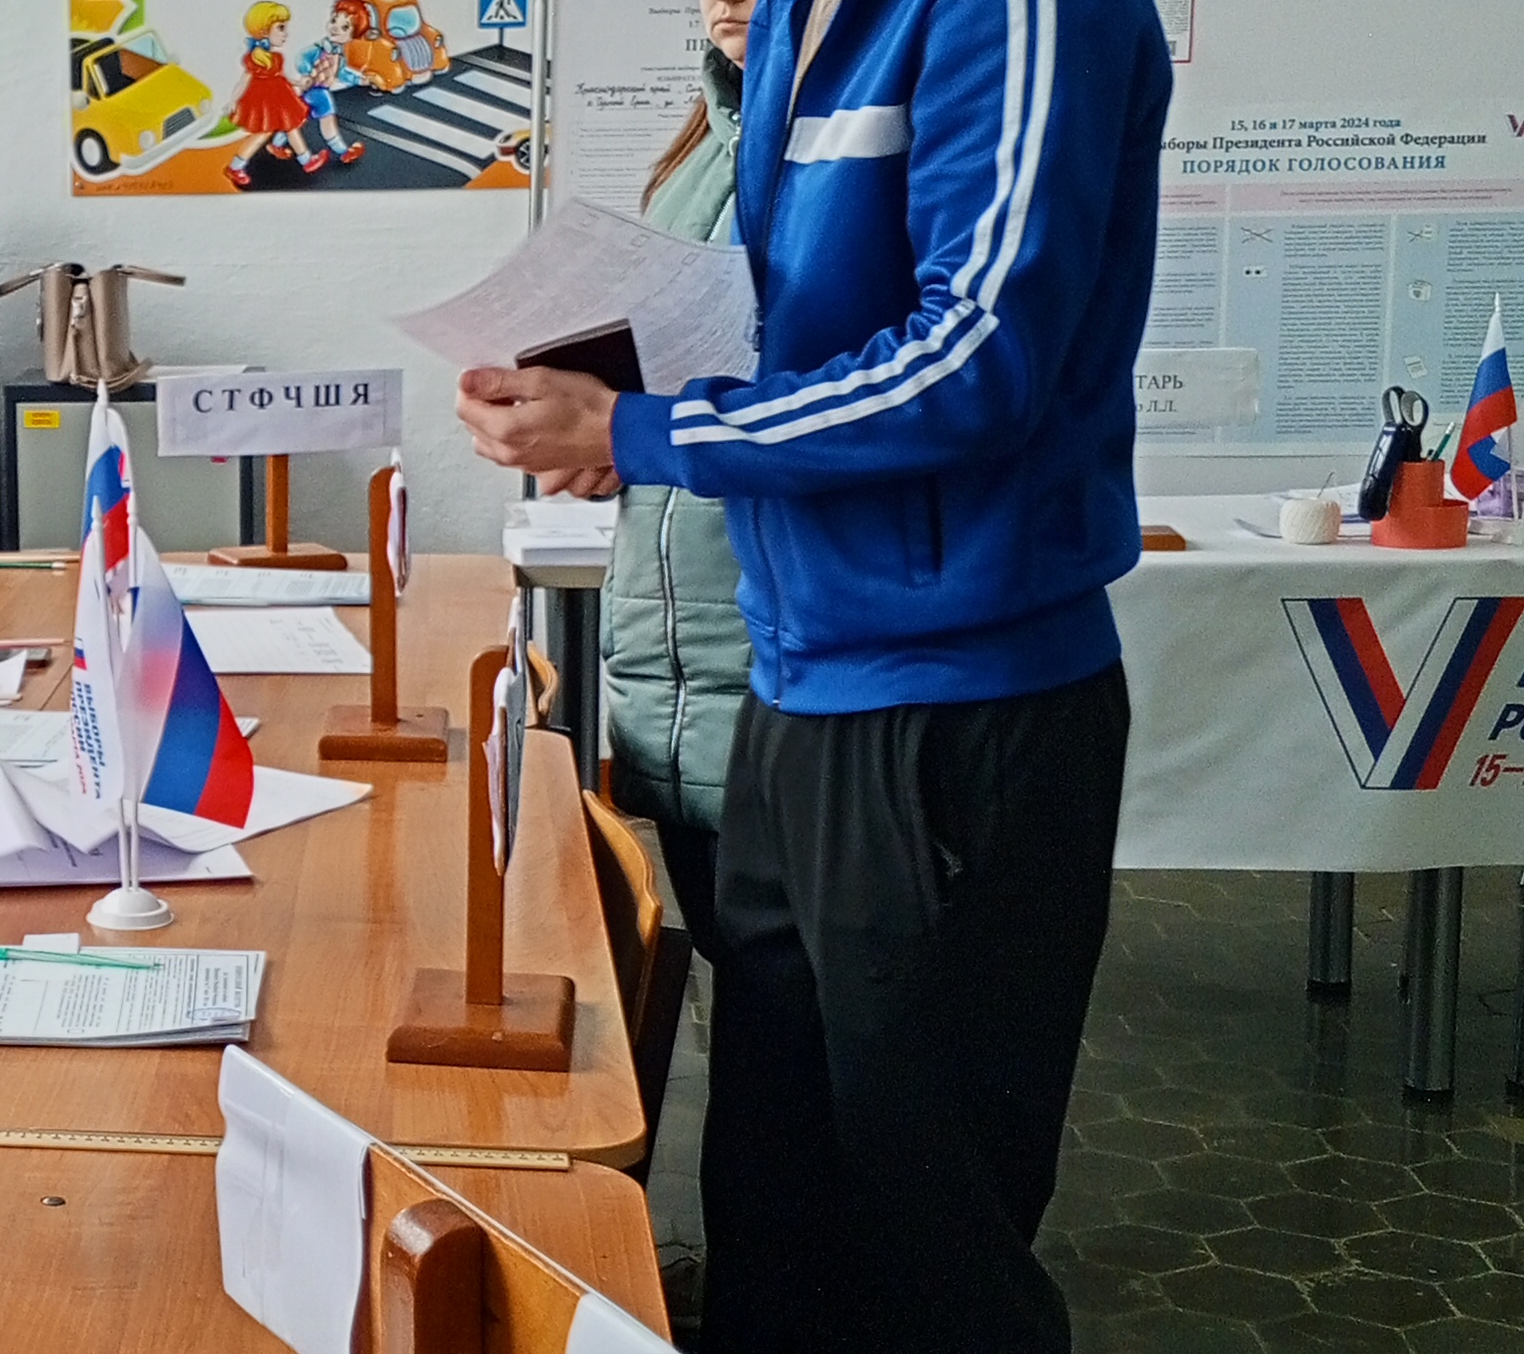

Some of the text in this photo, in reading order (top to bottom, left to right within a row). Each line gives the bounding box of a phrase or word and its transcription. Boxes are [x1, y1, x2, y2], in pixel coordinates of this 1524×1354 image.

[1230, 120, 1248, 132] 15,
[1252, 119, 1267, 130] 16
[1282, 118, 1296, 129] 17
[1298, 120, 1337, 132] марта
[1340, 117, 1370, 129] 2024
[1372, 119, 1401, 131] года
[1162, 132, 1487, 154] боры Президента Российской Федерации
[1182, 155, 1447, 175] ПОРЯДОК ГОЛОСОВАНИЯ
[1136, 375, 1184, 389] ТАРЬ
[84, 683, 106, 767] ВЫБОРЫ
[75, 681, 101, 799] ПРЕЗИДЕНТА
